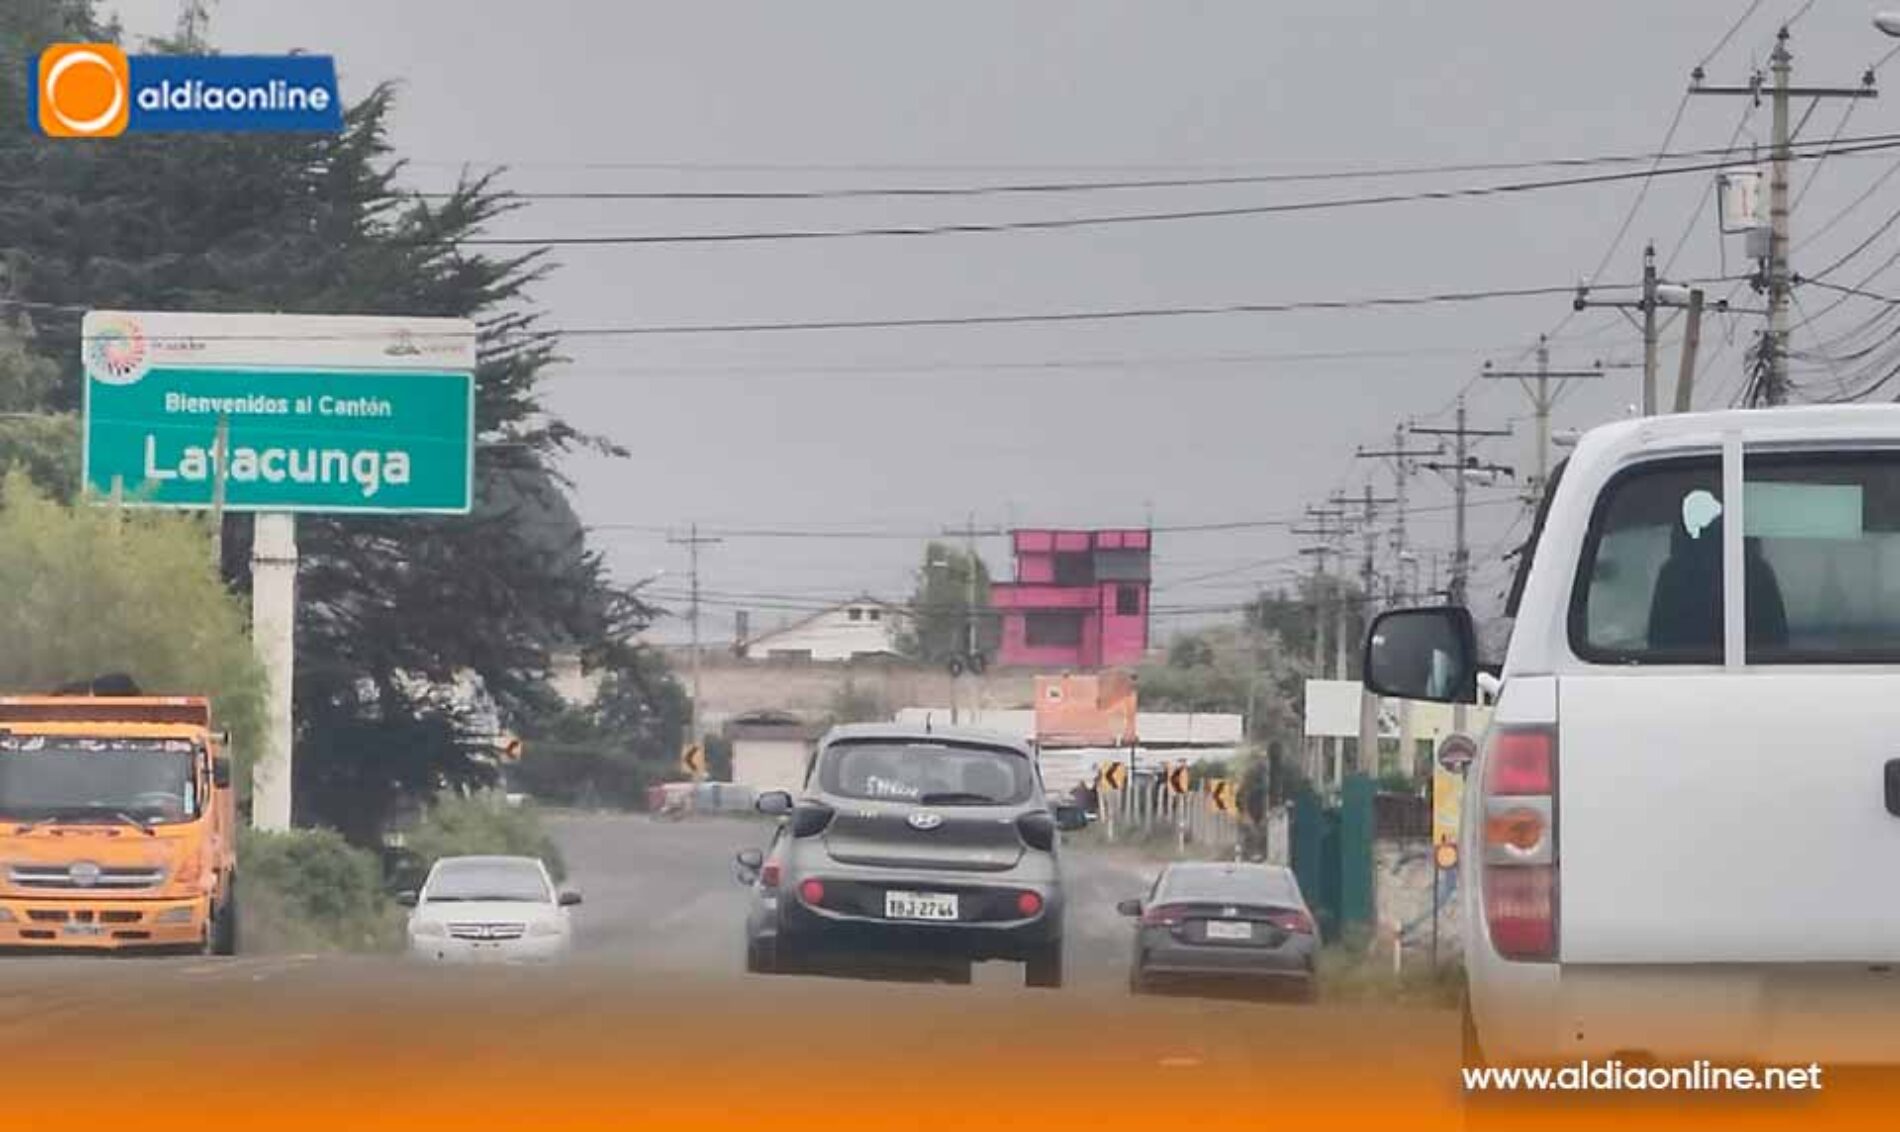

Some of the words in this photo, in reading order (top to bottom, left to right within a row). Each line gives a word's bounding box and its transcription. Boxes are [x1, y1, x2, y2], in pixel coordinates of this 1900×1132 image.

[164, 391, 289, 415] Bienvenidos
[295, 395, 312, 415] al
[318, 394, 392, 417] Cantón
